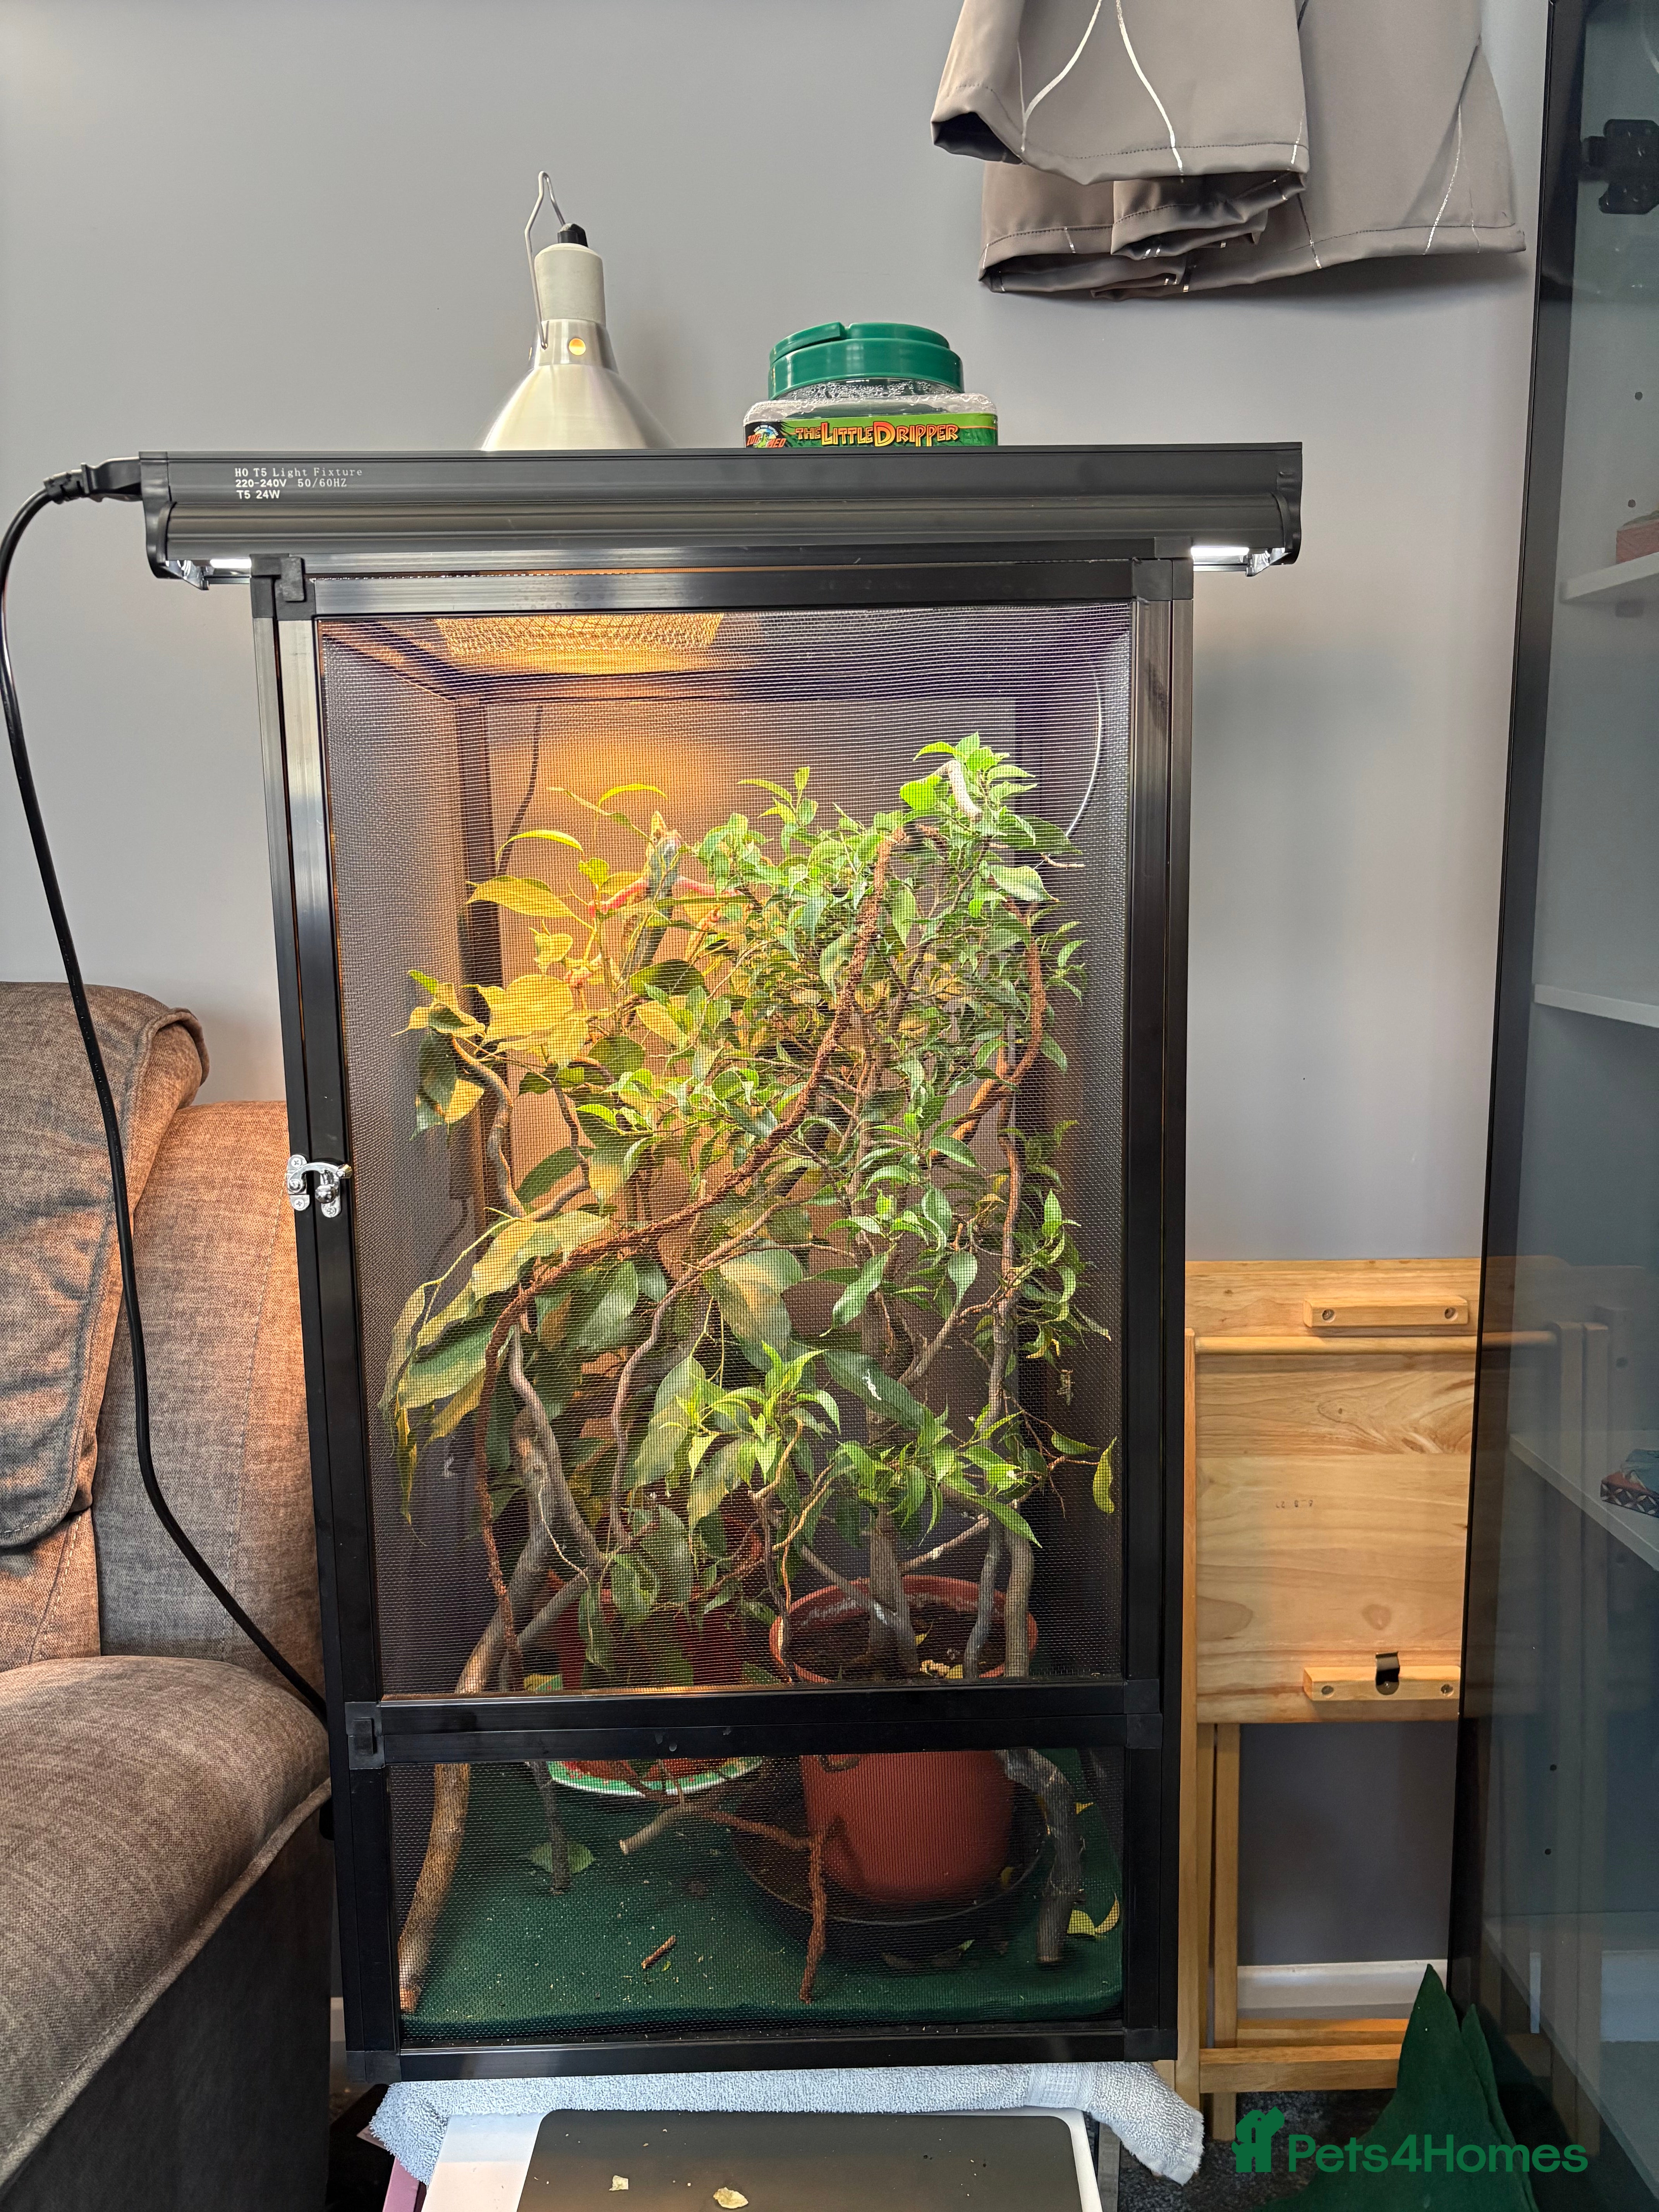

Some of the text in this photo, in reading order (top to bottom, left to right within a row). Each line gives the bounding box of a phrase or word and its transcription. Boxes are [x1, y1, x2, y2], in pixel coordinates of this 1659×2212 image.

[795, 427, 821, 440] THE
[821, 422, 874, 446] LITTLE
[873, 421, 959, 447] DRIPPER
[253, 467, 267, 477] T5
[273, 467, 307, 478] Light
[313, 467, 363, 476] Fixture
[235, 478, 347, 488] 220-240V 50/60HZ
[236, 489, 280, 499] T5 24W
